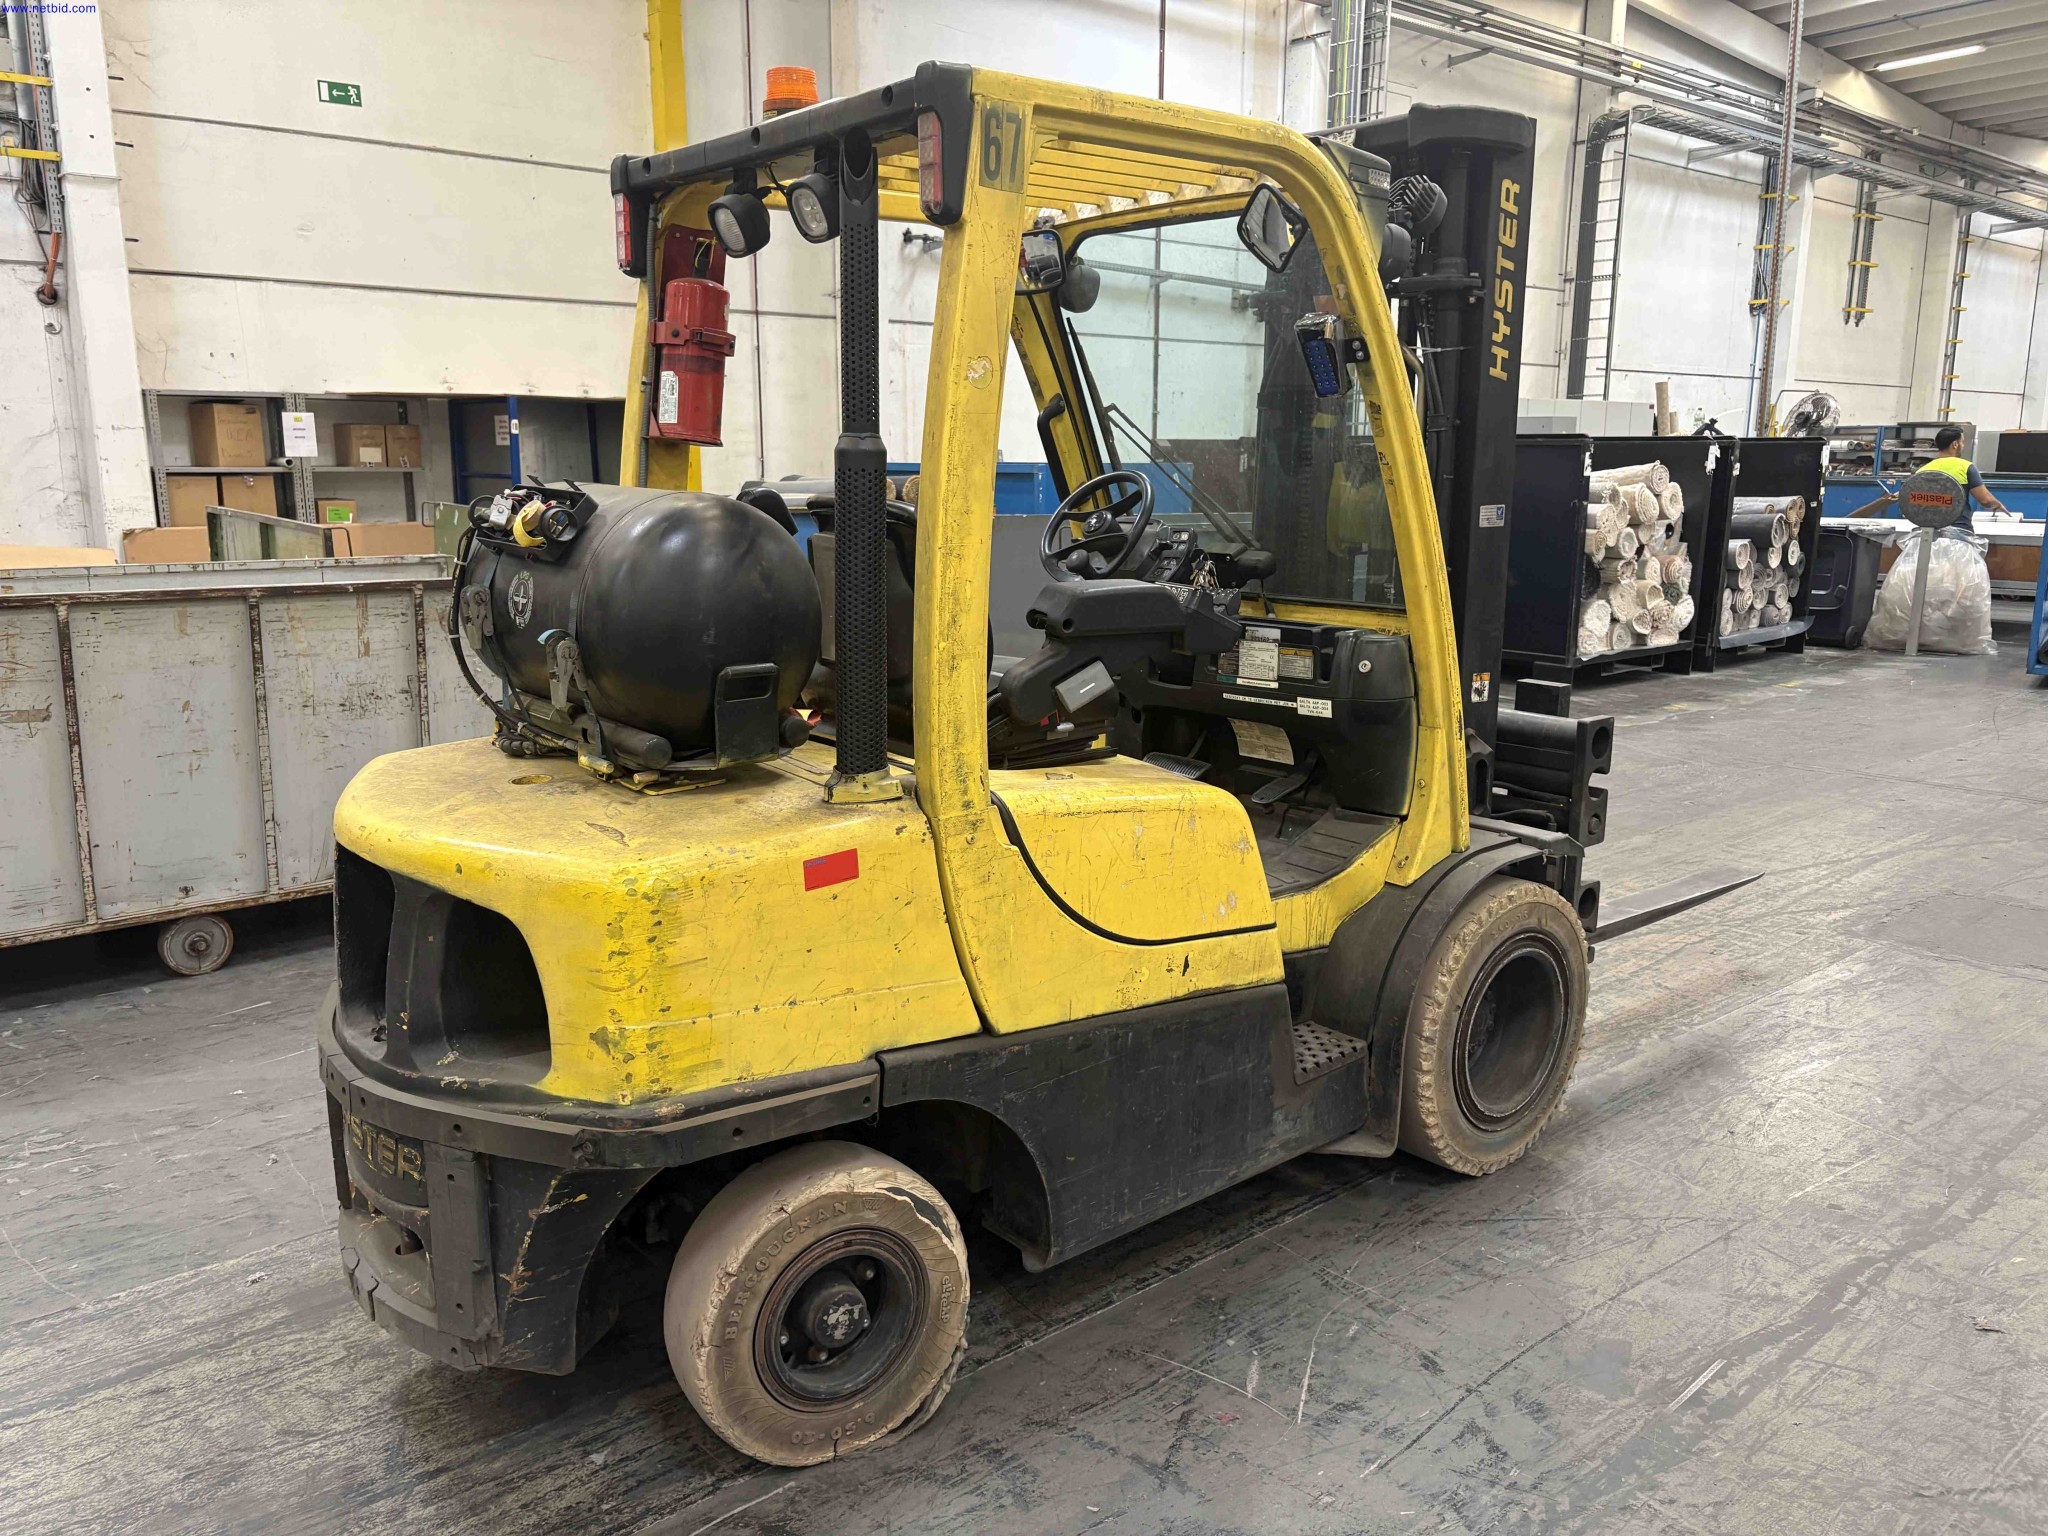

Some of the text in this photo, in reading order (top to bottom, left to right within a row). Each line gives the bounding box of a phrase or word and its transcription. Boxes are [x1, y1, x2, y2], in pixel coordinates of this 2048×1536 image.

[984, 107, 1022, 184] 67
[1489, 178, 1521, 382] HYSTER
[1911, 492, 1953, 506] Plastiek
[344, 1114, 422, 1181] STER
[725, 1200, 849, 1341] BERGOUGNAN
